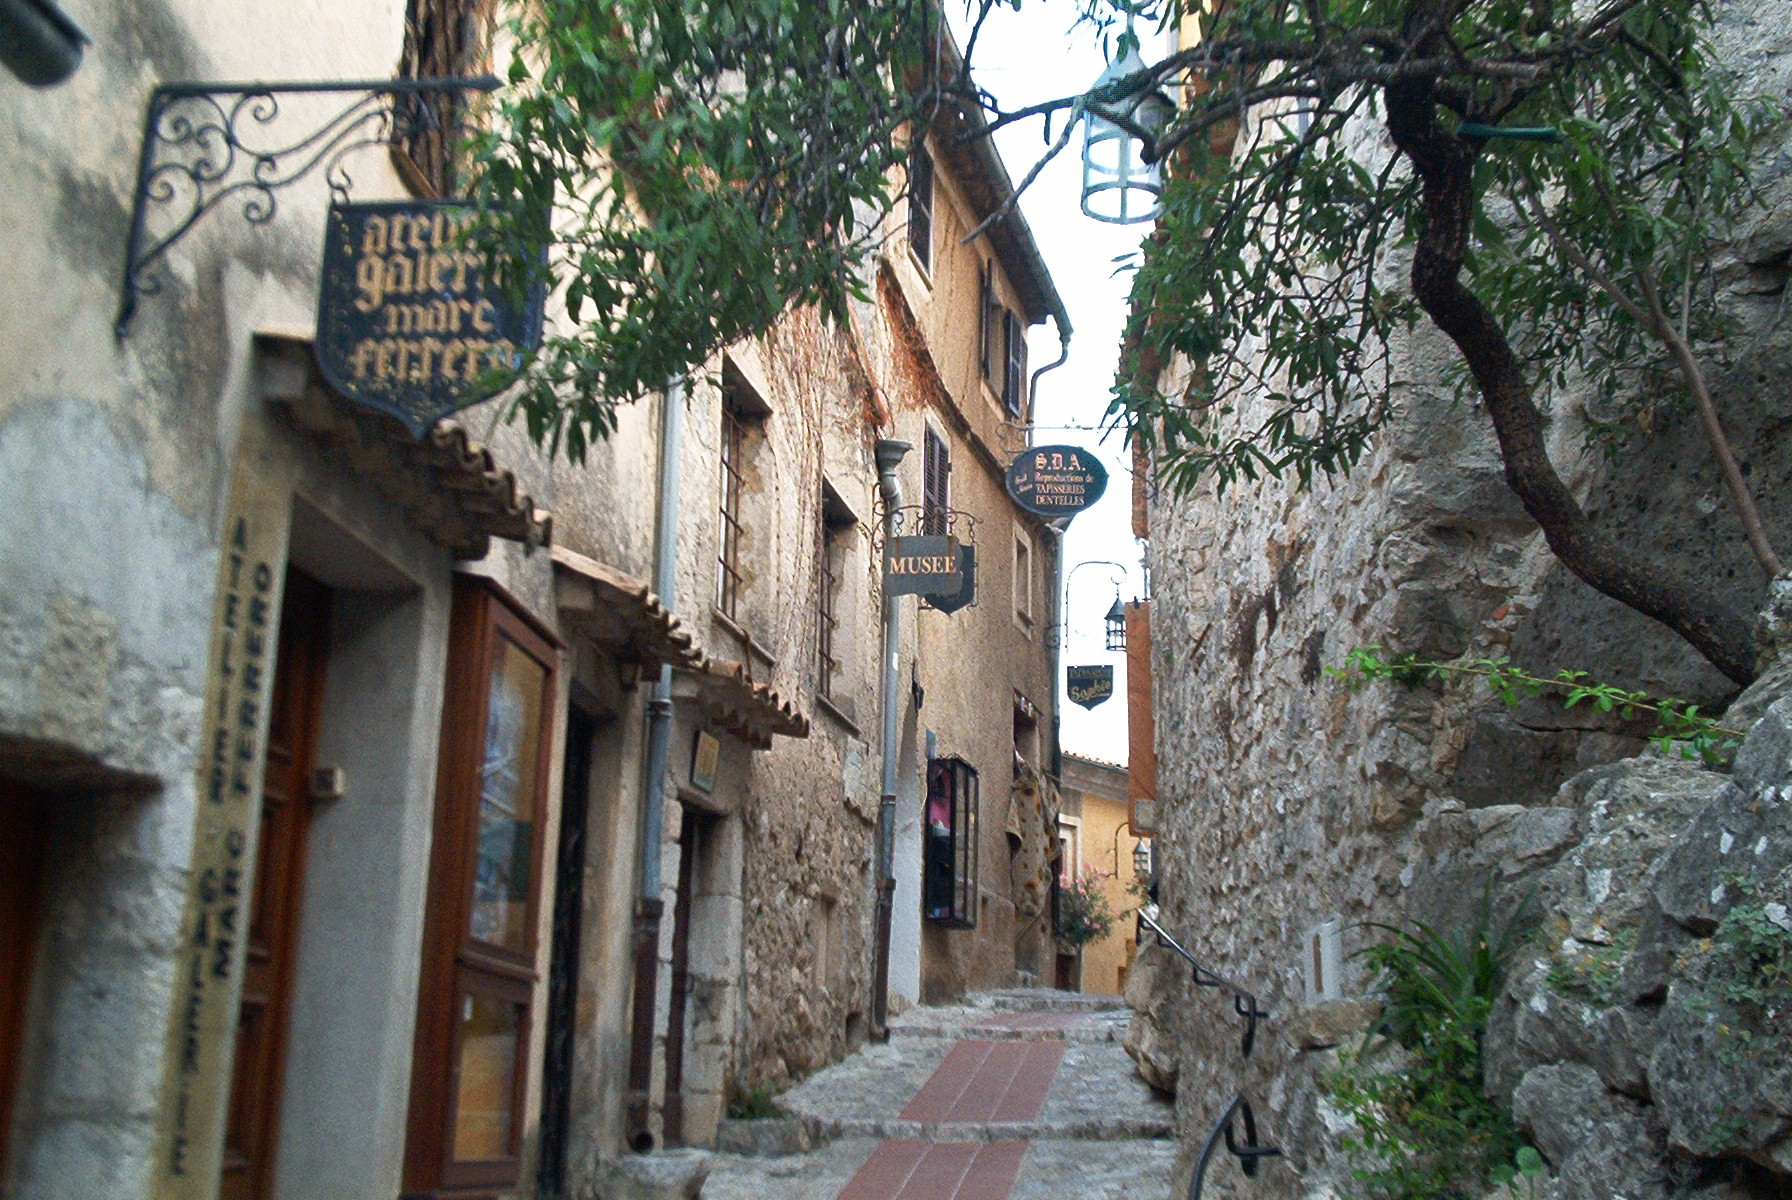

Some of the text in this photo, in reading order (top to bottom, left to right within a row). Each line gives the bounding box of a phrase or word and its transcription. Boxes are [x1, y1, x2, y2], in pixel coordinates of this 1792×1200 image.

[383, 299, 495, 333] marc
[349, 337, 515, 383] ferrero
[1036, 495, 1085, 506] DENTELLES
[889, 555, 957, 575] MUSEE
[210, 517, 246, 804] ATELIER
